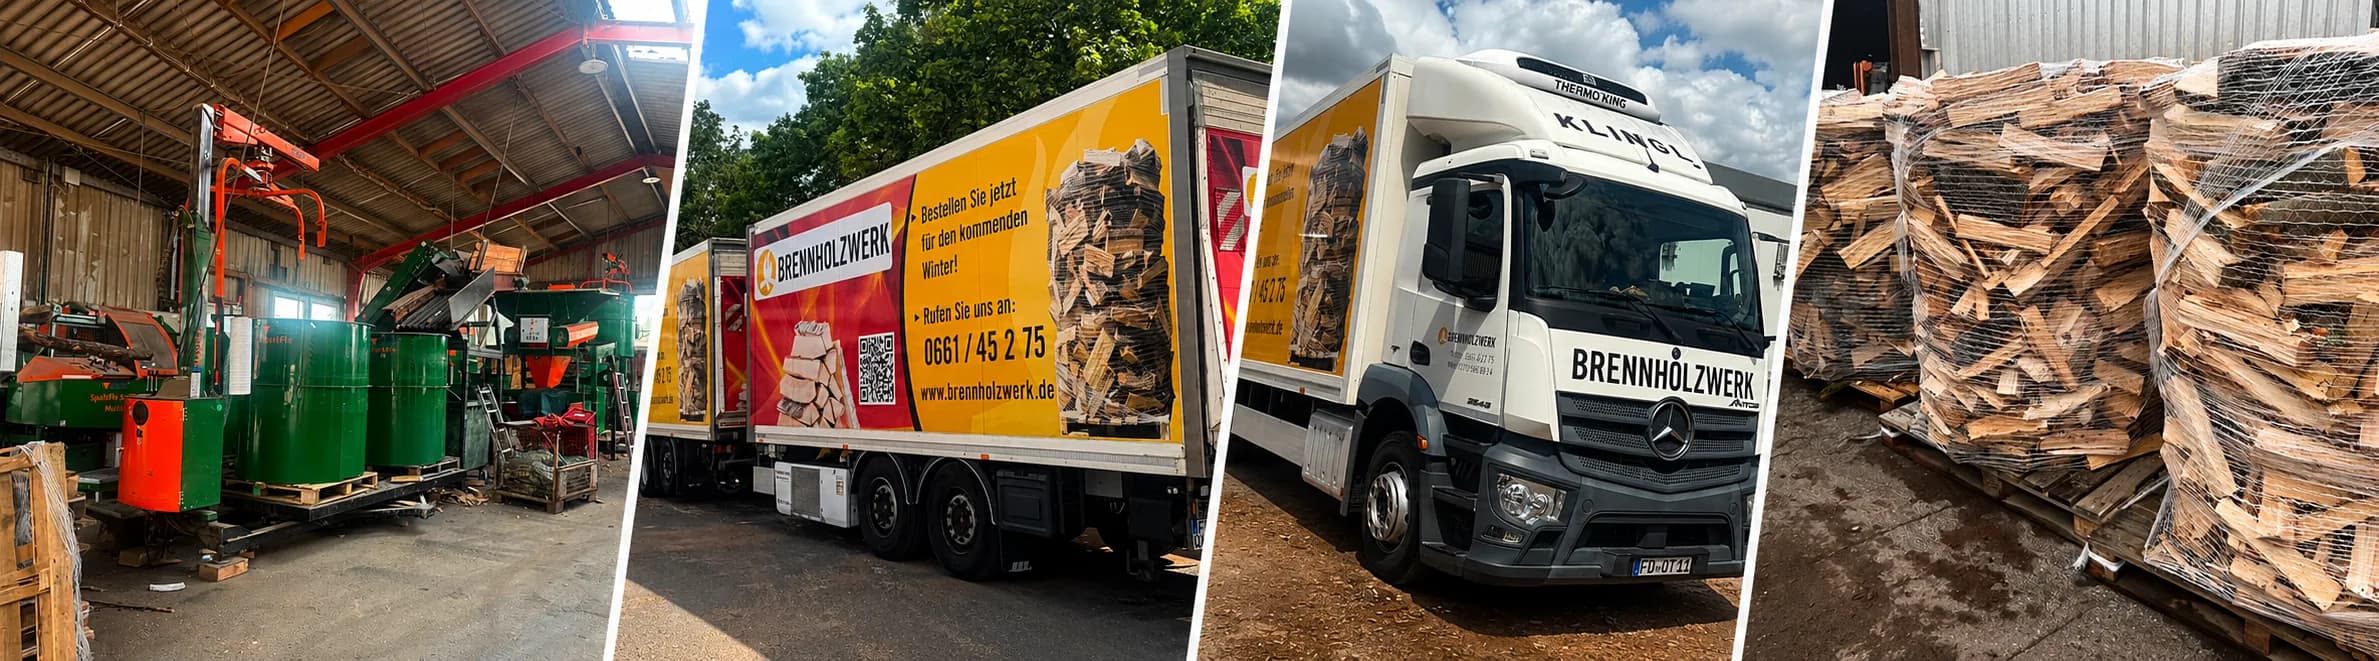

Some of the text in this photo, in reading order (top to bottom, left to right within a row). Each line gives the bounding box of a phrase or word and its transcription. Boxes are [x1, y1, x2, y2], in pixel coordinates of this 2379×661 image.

[1555, 79, 1627, 109] THERMO KING
[921, 177, 1017, 224] Bestellen Sie jetzt
[921, 209, 1028, 252] für den kommenden
[777, 222, 890, 283] BRENNHOLZWERK
[921, 254, 958, 280] Winter!
[923, 297, 1016, 325] Rufen Sie uns an:
[924, 324, 1046, 366] 0661 / 45 2 75
[1448, 331, 1497, 349] BRENNHOLZWERK
[1572, 347, 1754, 401] BRENNHOLZWERK
[920, 379, 1055, 401] www.brennholzwerk.de
[1640, 559, 1656, 575] FD
